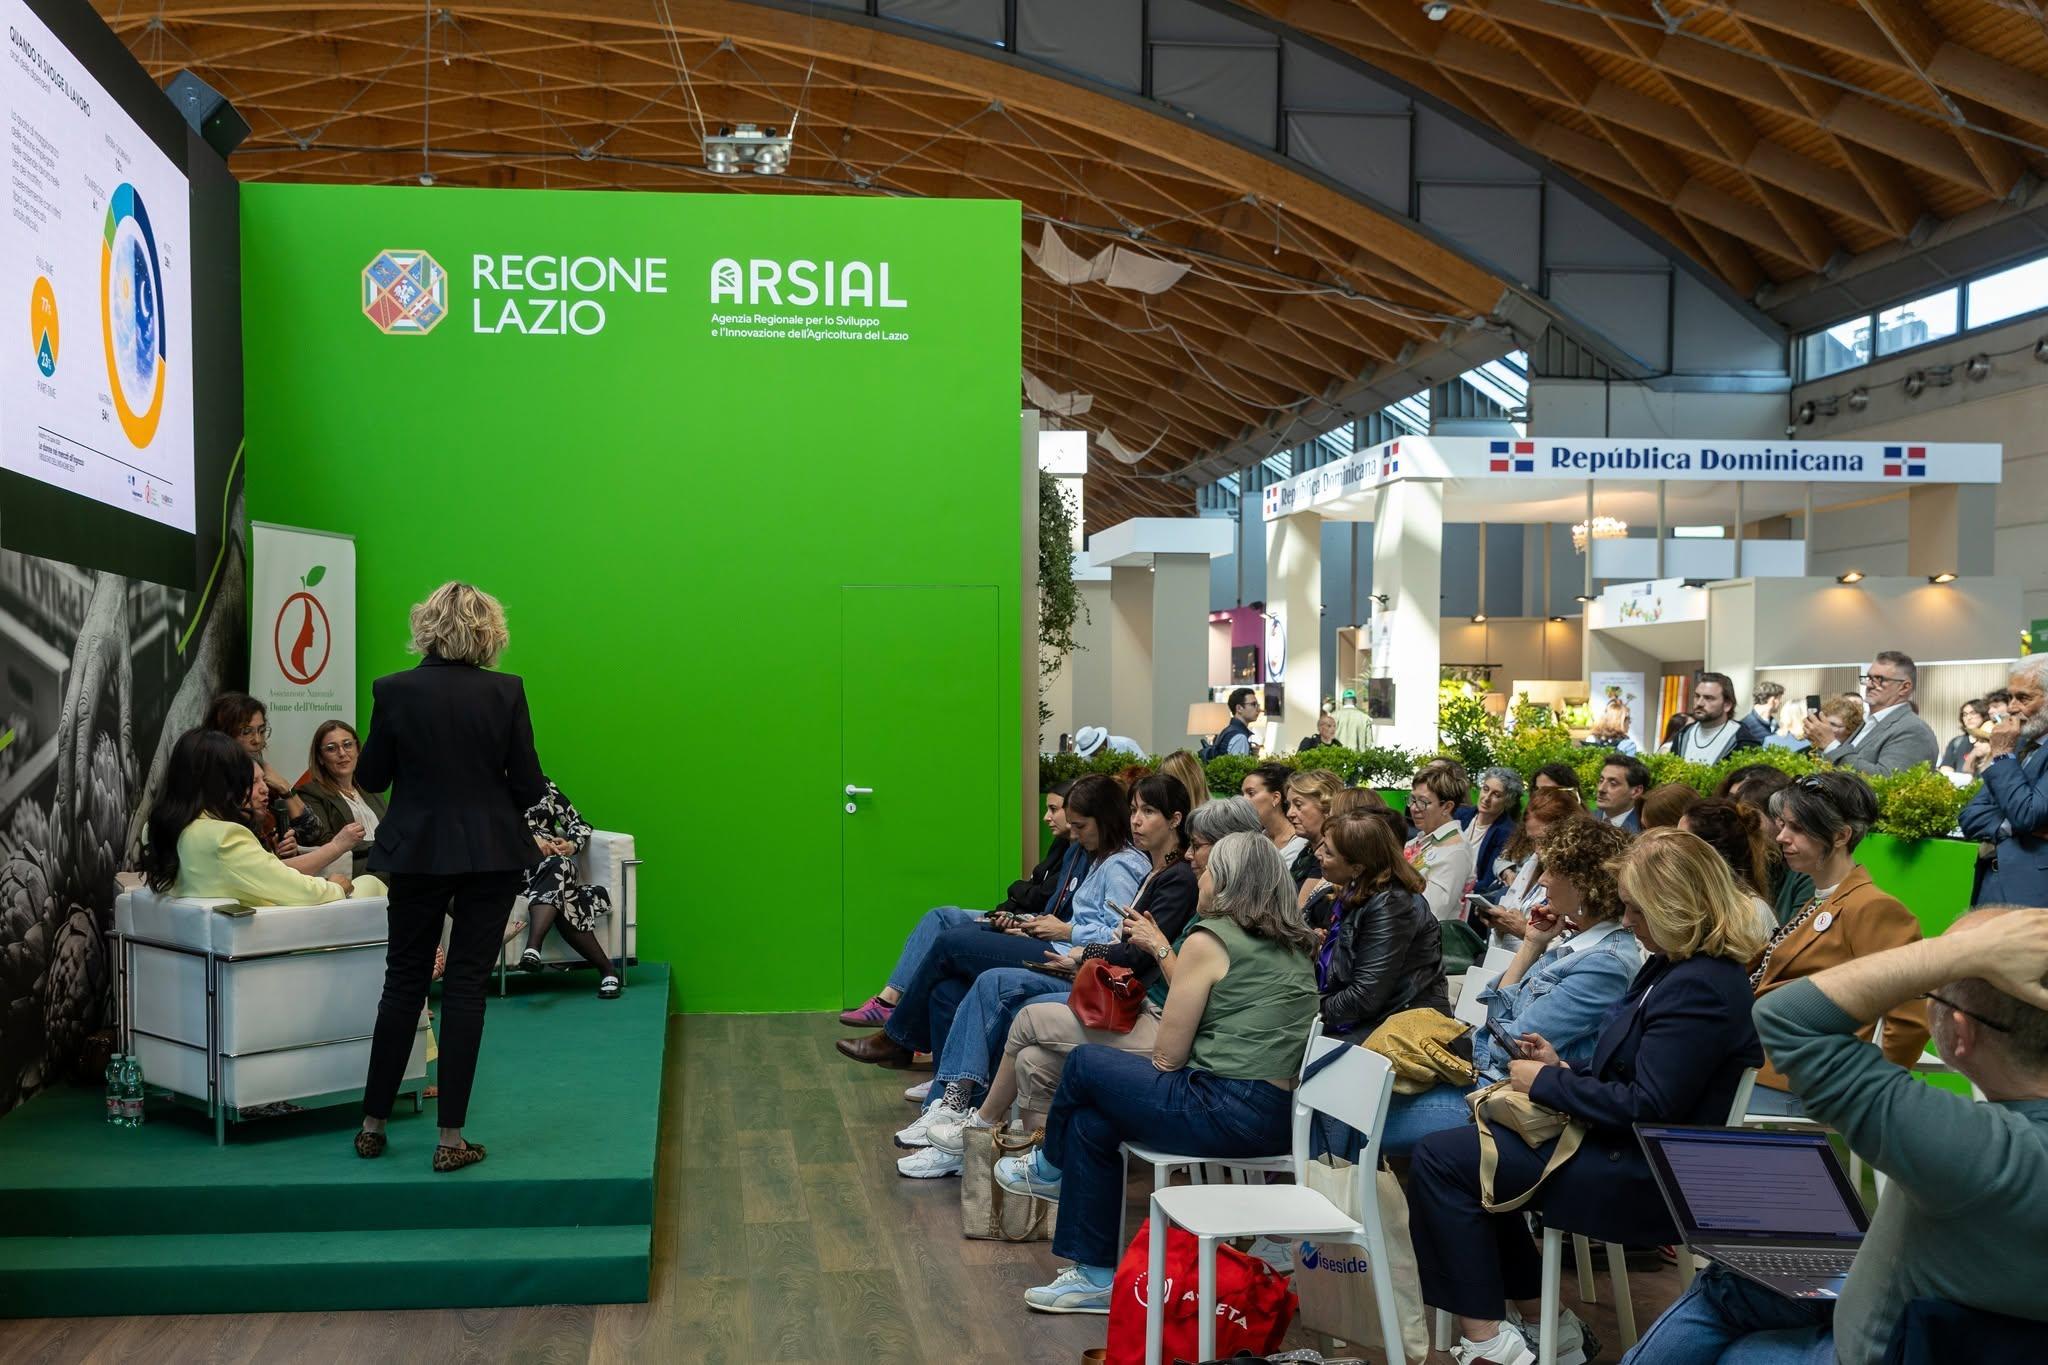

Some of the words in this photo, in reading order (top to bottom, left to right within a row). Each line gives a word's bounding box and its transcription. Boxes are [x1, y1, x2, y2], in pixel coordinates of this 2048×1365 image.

[10, 25, 36, 62] QUANDO
[37, 53, 43, 70] SI
[43, 59, 64, 92] SVOLGE
[70, 88, 91, 118] LAVORO
[474, 254, 667, 294] REGIONE
[711, 257, 908, 308] ARSIAL
[474, 299, 605, 336] LAZIO
[711, 313, 752, 326] Agenzia
[754, 314, 803, 327] Regionale
[805, 318, 822, 327] per
[825, 315, 834, 325] lo
[836, 315, 880, 327] Sviluppo
[720, 328, 785, 338] l'Innovazione
[787, 328, 862, 341] dell'Agricoltura
[865, 331, 880, 340] del
[882, 331, 909, 341] Lazio
[41, 350, 51, 370] 23%
[1551, 447, 1690, 473] República
[1700, 448, 1863, 472] Dominicana
